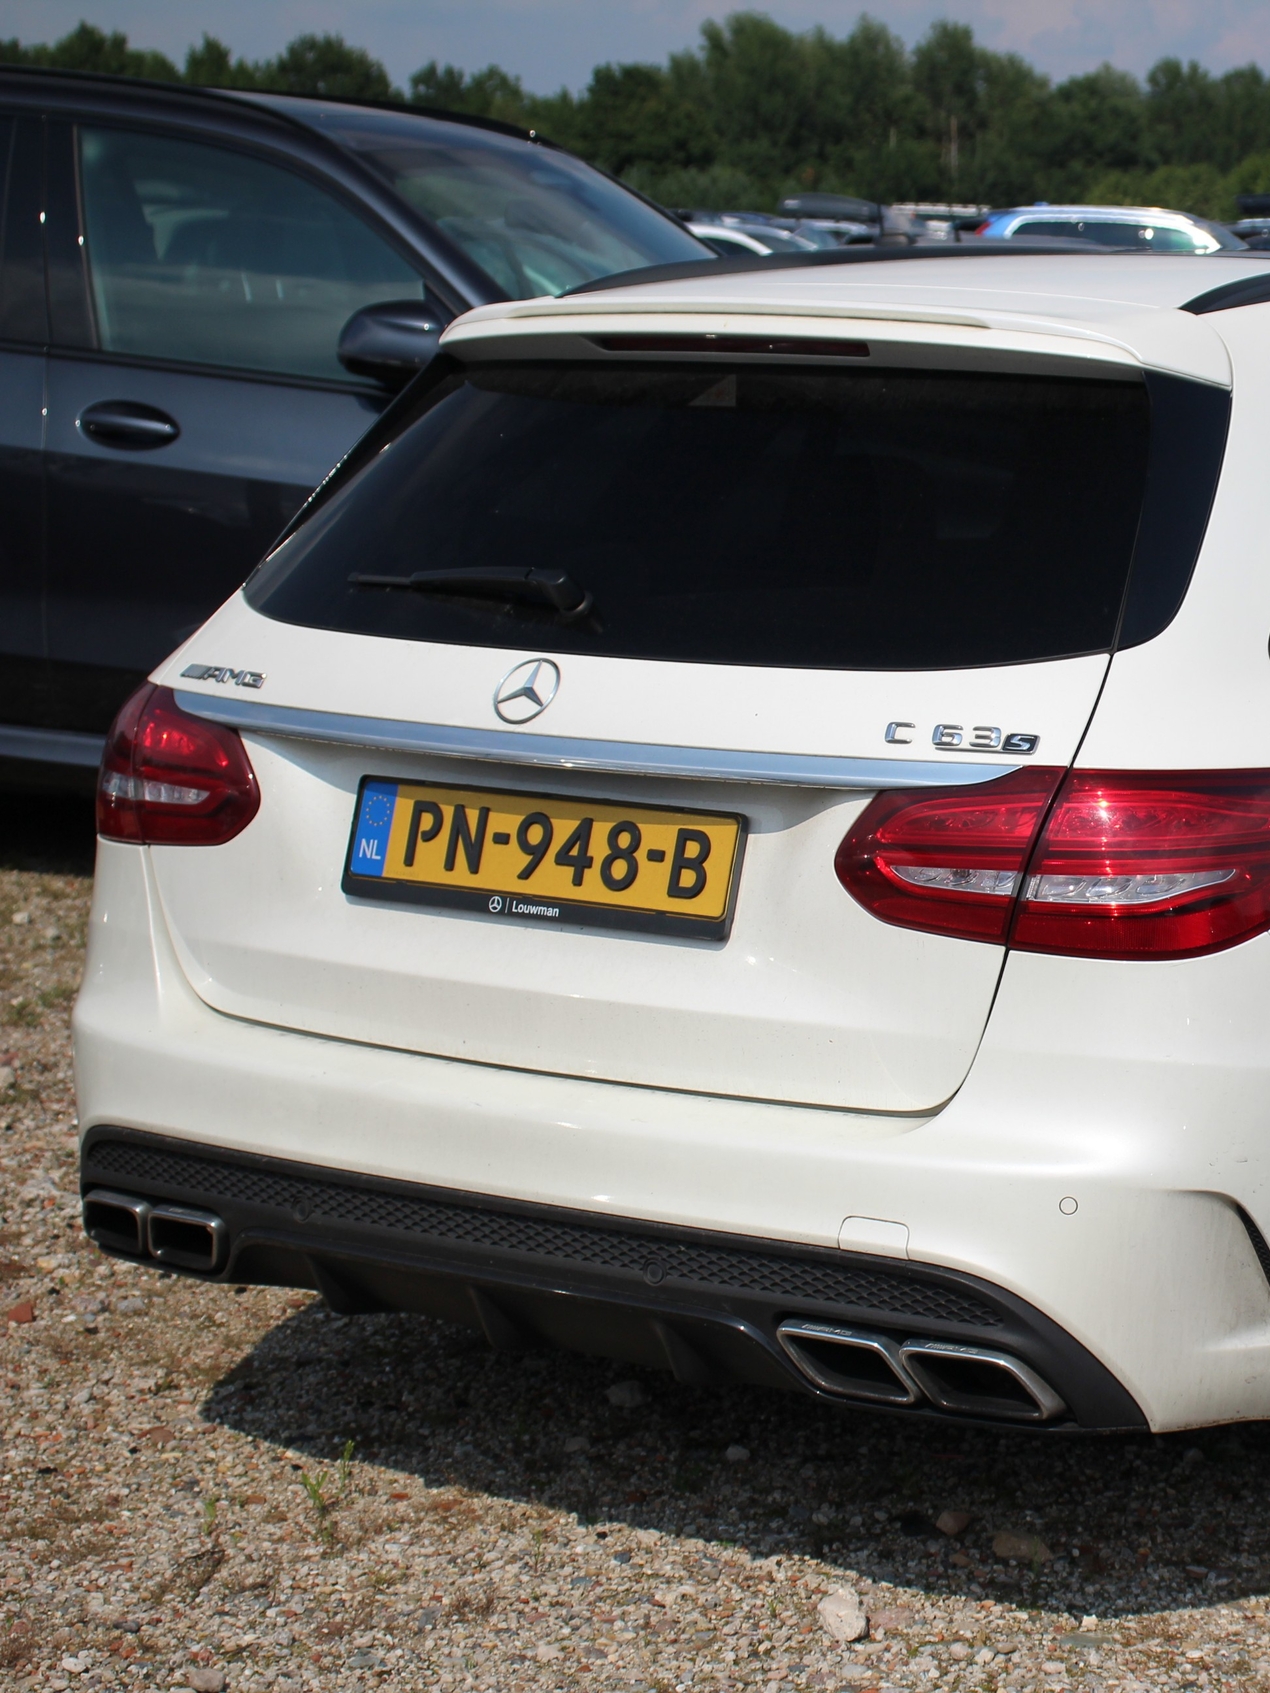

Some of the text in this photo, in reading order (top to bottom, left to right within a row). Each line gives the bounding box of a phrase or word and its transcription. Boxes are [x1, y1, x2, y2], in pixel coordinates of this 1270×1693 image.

[198, 665, 267, 689] AMG
[885, 722, 916, 744] C
[358, 838, 382, 861] NL
[403, 799, 713, 899] PN-948-B
[511, 901, 560, 918] Louwman
